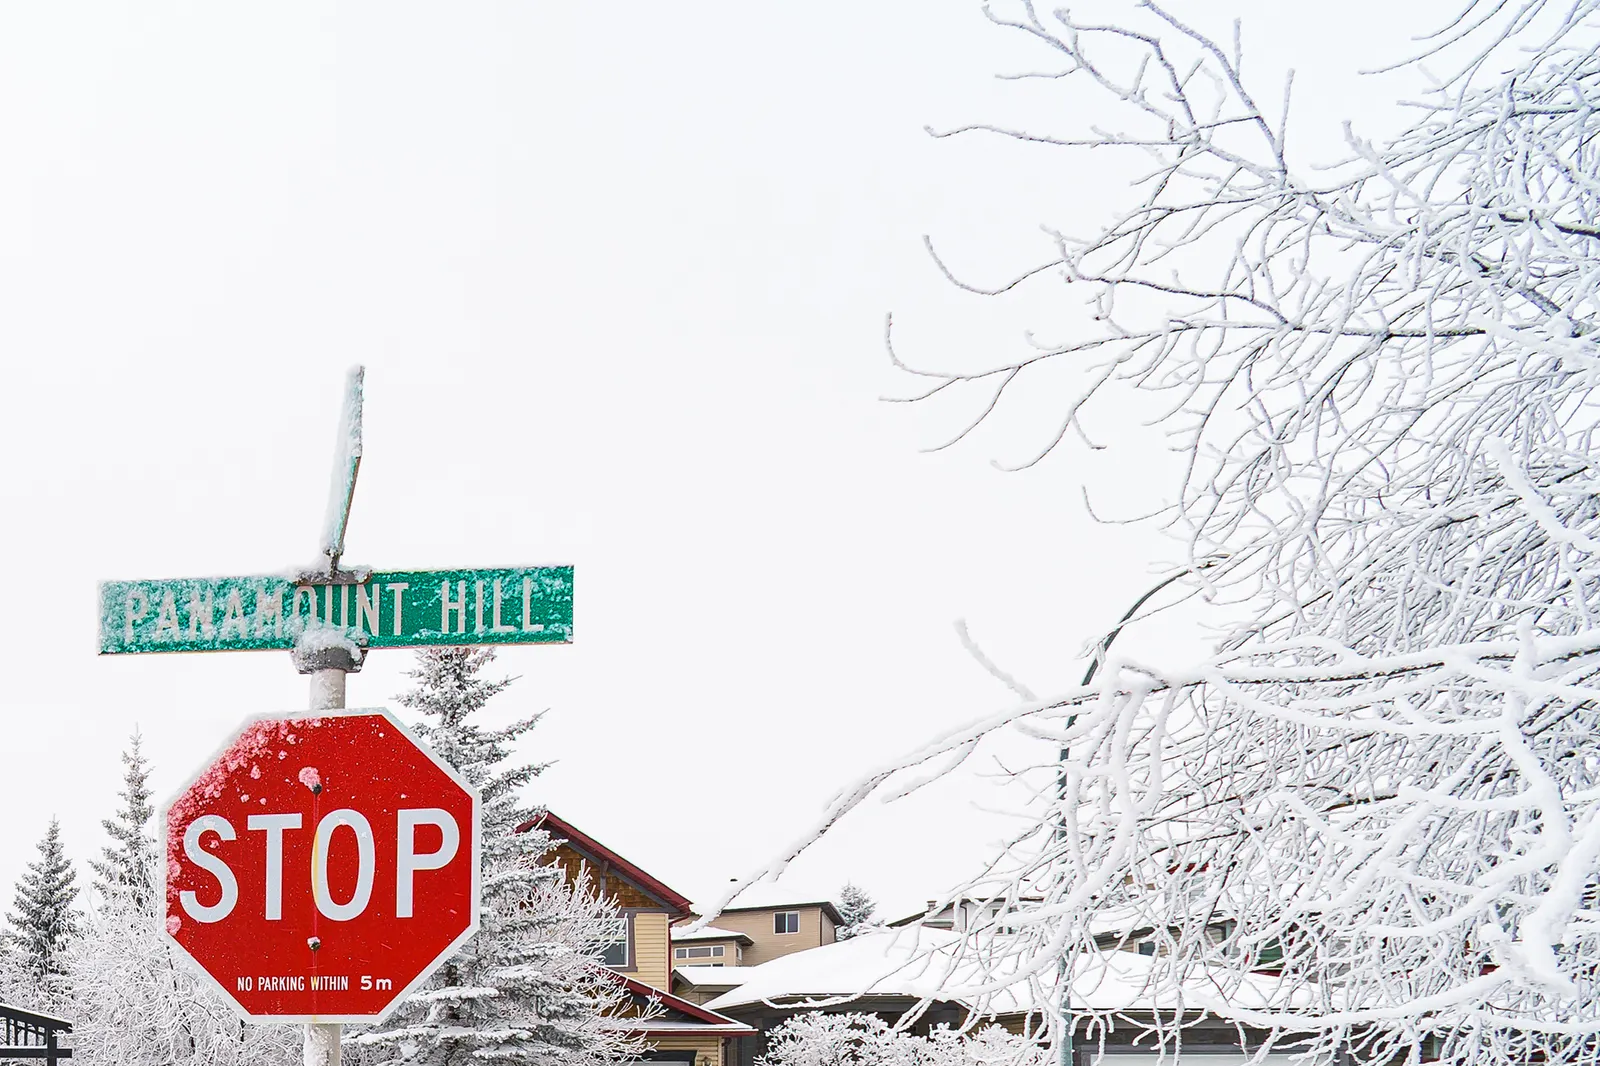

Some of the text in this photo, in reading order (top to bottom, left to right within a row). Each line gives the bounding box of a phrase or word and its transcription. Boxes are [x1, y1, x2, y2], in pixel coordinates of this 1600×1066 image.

[124, 578, 545, 645] PANAMOUNT HILL
[179, 808, 461, 924] STOP
[237, 976, 253, 991] NO
[258, 976, 305, 991] PARKING
[310, 975, 349, 991] WITHIN
